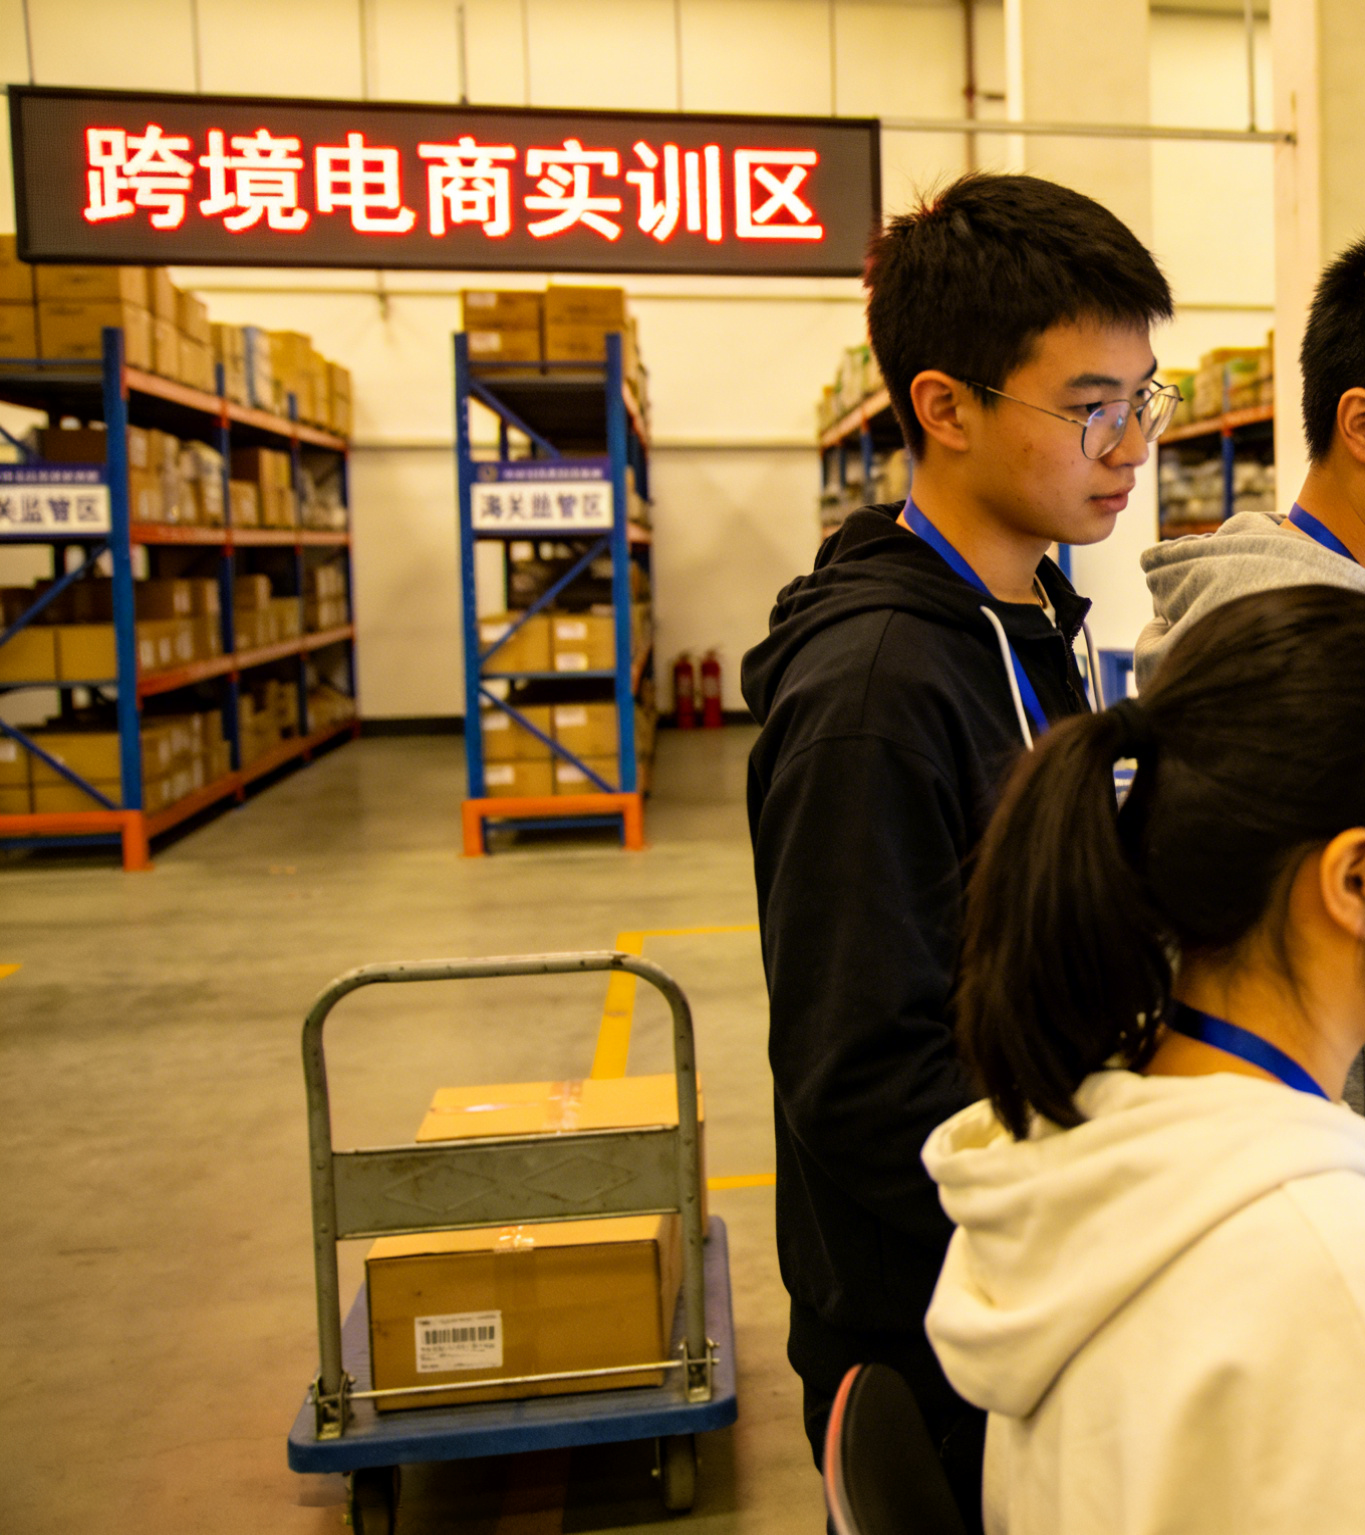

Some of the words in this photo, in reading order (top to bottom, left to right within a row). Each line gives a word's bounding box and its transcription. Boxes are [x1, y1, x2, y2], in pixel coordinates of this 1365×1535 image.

[83, 125, 824, 242] 跨境电商实训区
